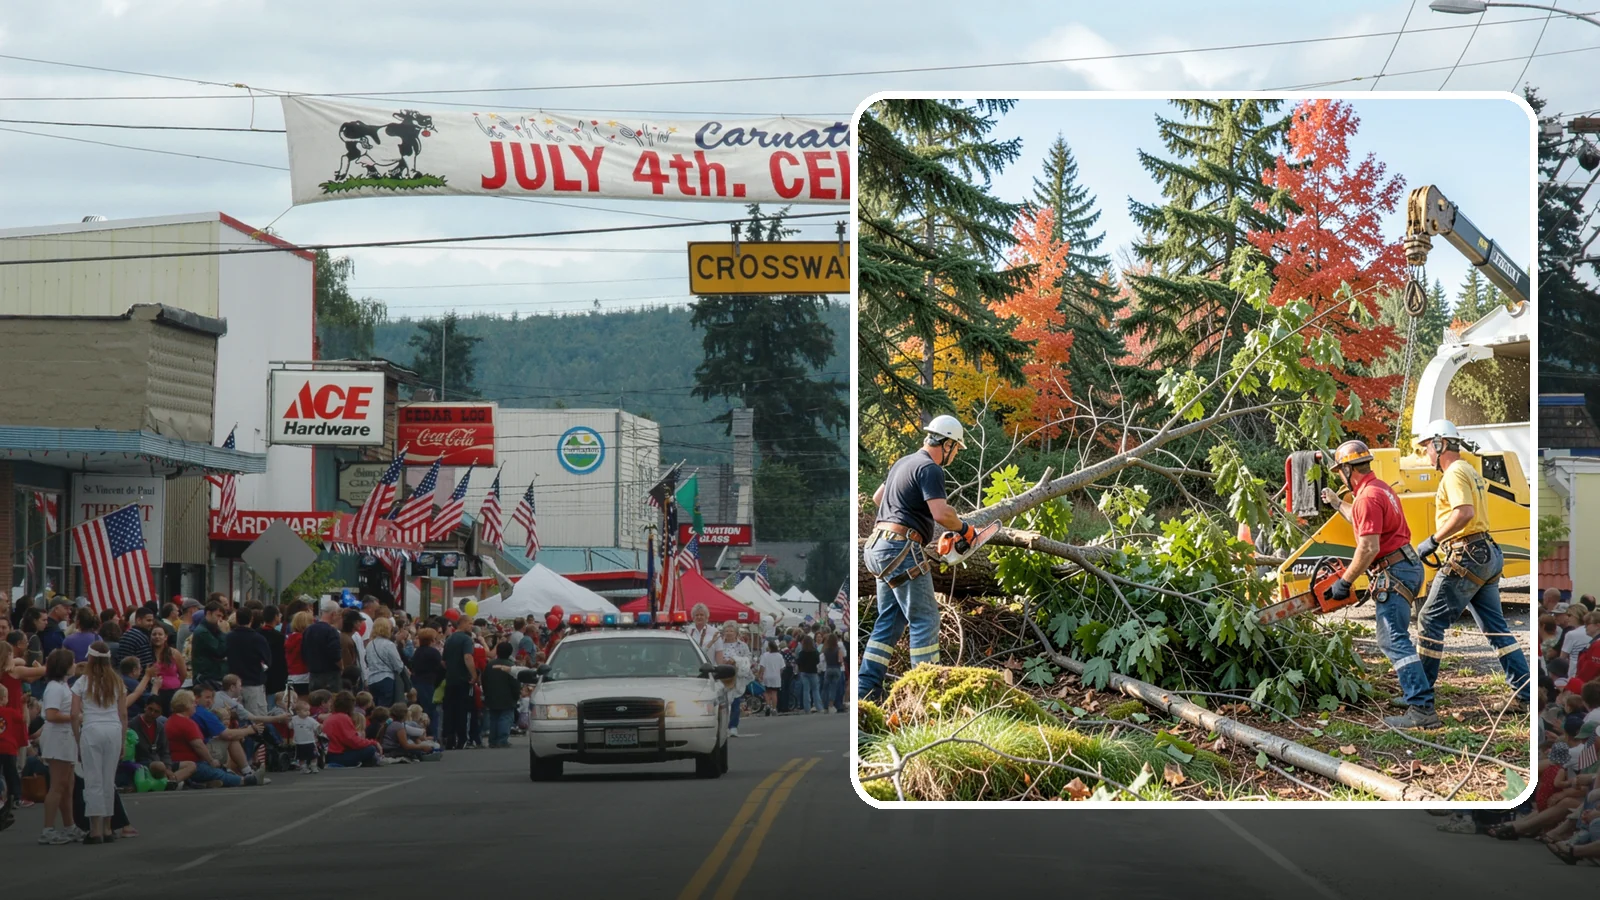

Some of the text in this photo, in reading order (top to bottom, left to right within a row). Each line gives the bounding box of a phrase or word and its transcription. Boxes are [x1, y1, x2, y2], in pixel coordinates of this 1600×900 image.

[481, 141, 605, 191] JULY
[632, 150, 746, 198] 4th.
[696, 254, 850, 280] CROSSWA
[282, 380, 373, 420] ACE
[405, 409, 453, 422] CEDAR
[283, 421, 370, 436] Hardware
[416, 428, 477, 447] Coca-Cola
[95, 485, 124, 494] Vincent
[126, 486, 136, 494] de
[138, 486, 155, 495] Paul
[688, 526, 741, 535] CRNATION
[699, 535, 730, 543] GLASS
